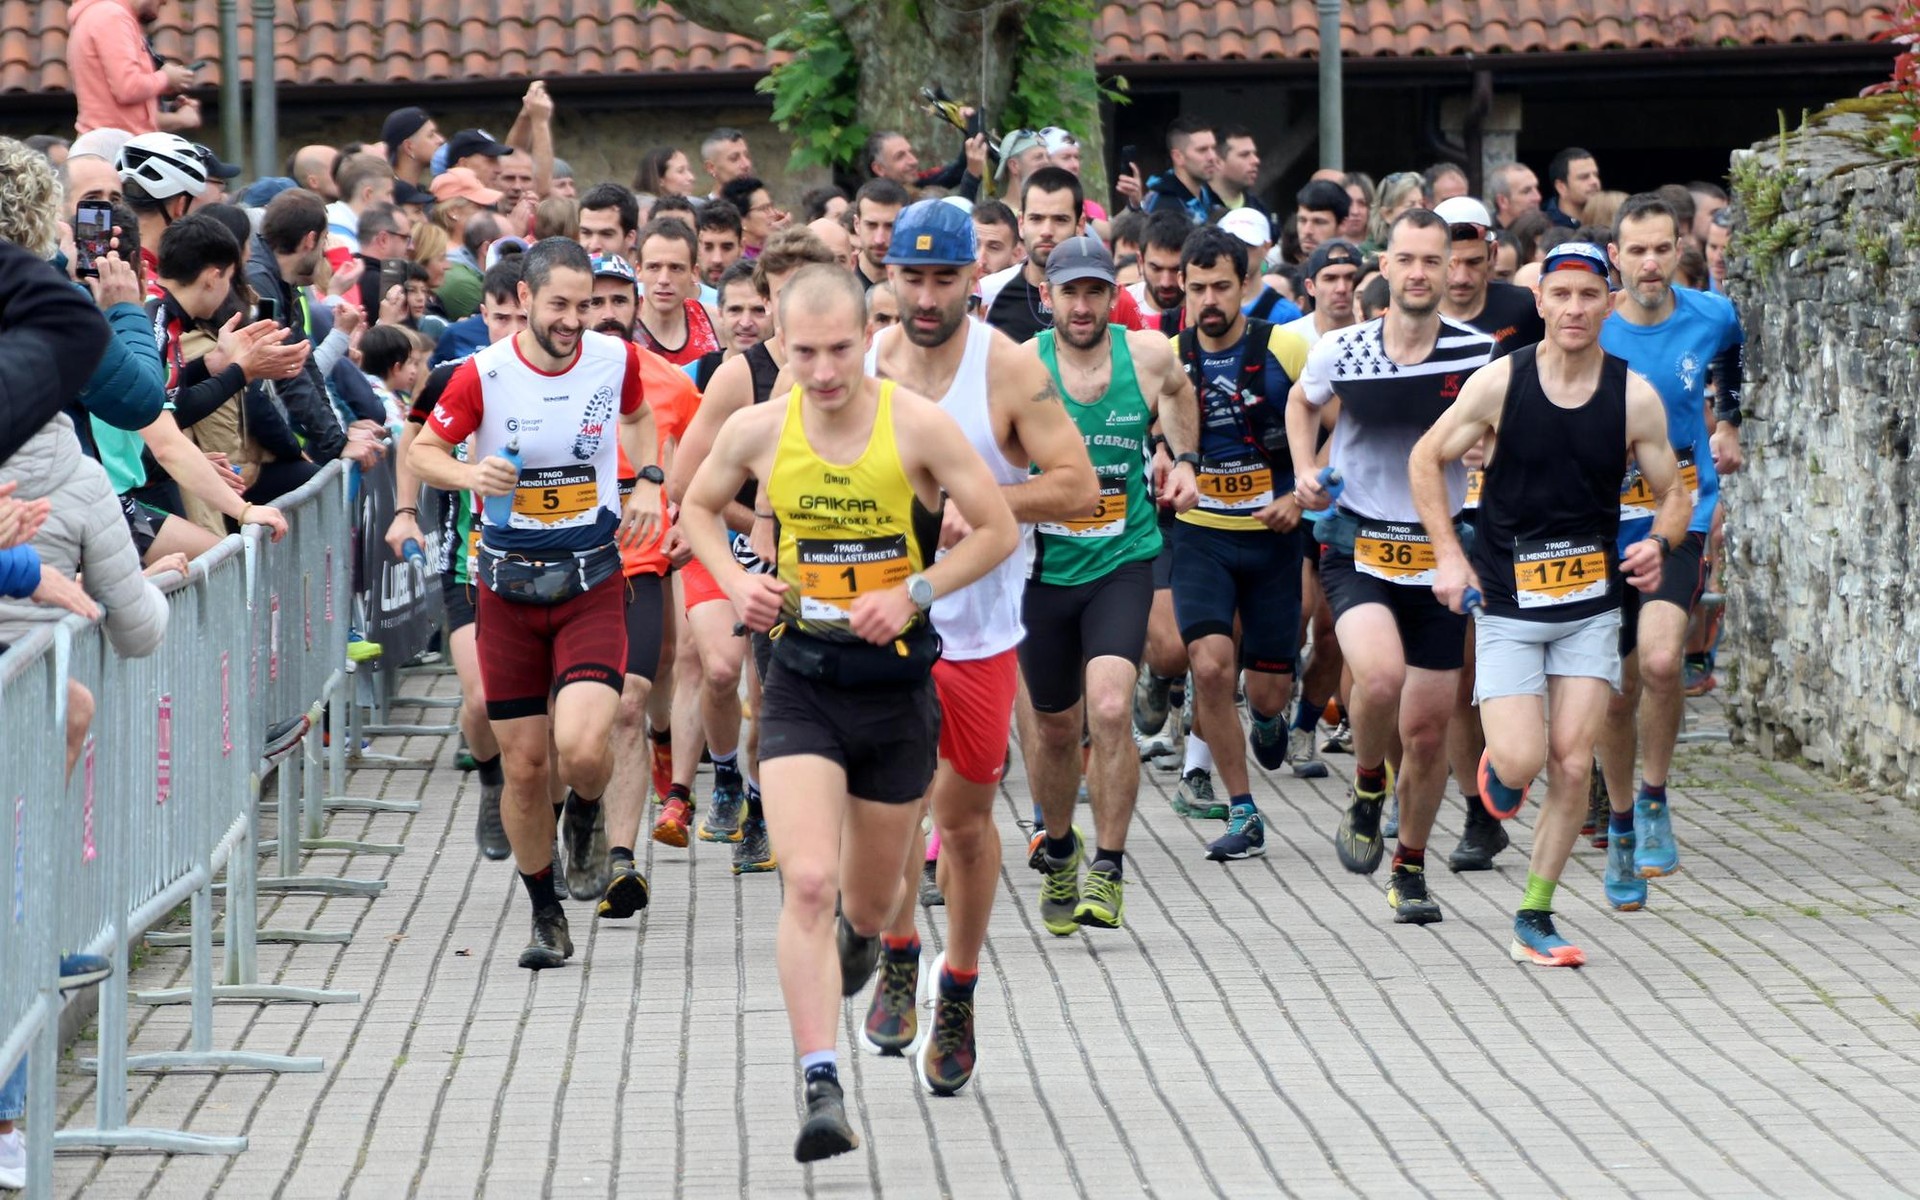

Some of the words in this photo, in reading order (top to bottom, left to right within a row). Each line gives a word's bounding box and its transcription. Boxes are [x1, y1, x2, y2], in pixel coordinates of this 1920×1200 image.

[1225, 463, 1264, 474] LASTERKETA
[543, 475, 590, 486] LASTERKETA
[1211, 474, 1253, 493] 189
[543, 489, 559, 510] 5
[799, 495, 878, 512] GAIKAR
[1368, 531, 1390, 539] MENDI
[1390, 533, 1431, 542] LASTERKET
[833, 544, 838, 553] 7
[839, 544, 863, 553] PAGO
[1526, 551, 1550, 560] MENDI
[1551, 545, 1596, 557] LASTERKETA
[1550, 541, 1570, 550] PAGO
[812, 554, 840, 562] MENDI
[840, 549, 898, 562] LASTERKETA
[1378, 543, 1412, 565] 36
[1534, 558, 1585, 584] 174
[840, 566, 857, 592] 1
